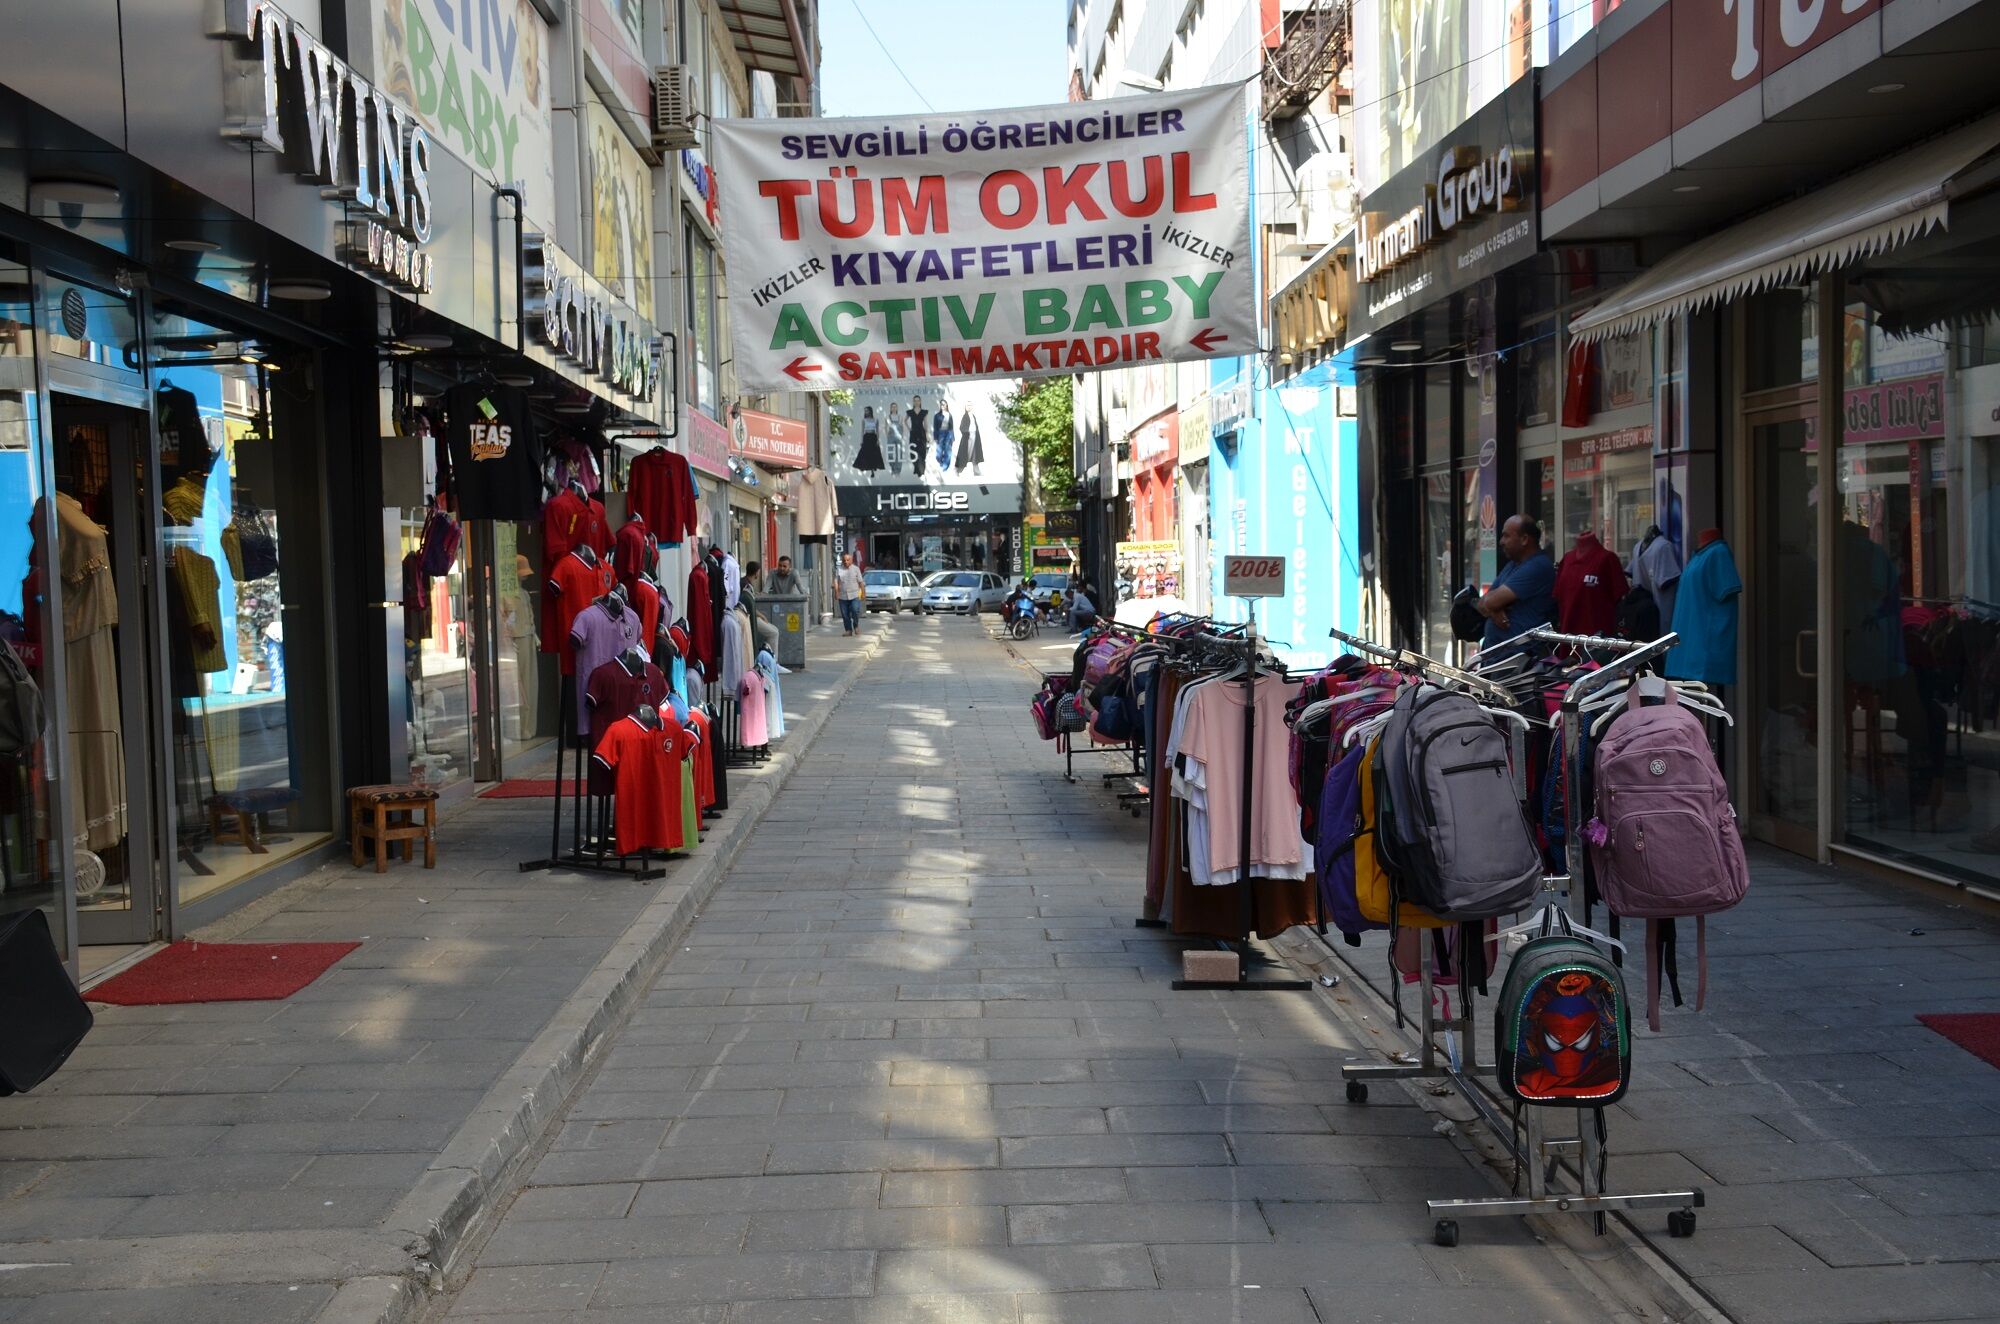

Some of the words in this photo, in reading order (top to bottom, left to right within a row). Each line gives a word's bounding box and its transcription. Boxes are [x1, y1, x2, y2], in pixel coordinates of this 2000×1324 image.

[404, 0, 519, 184] BABY
[247, 0, 432, 243] TWINS
[781, 125, 928, 160] SEVGİLİ
[941, 107, 1185, 153] ÖĞRENCİLER
[759, 165, 949, 241] TÜM
[978, 151, 1218, 230] OKUL
[1437, 145, 1512, 231] Group
[832, 223, 1153, 287] KIYAFETLERİ
[1162, 221, 1235, 270] İKİZLER
[751, 257, 826, 307] İKİZLER
[769, 291, 997, 351] ACTIV
[1023, 270, 1227, 337] BABY
[838, 331, 1161, 382] SATILMAKTADIR
[749, 436, 769, 452] AFŞİN
[770, 441, 805, 457] NOTERLİĞİ
[770, 422, 784, 436] T.C.
[1612, 431, 1639, 449] TELEFON
